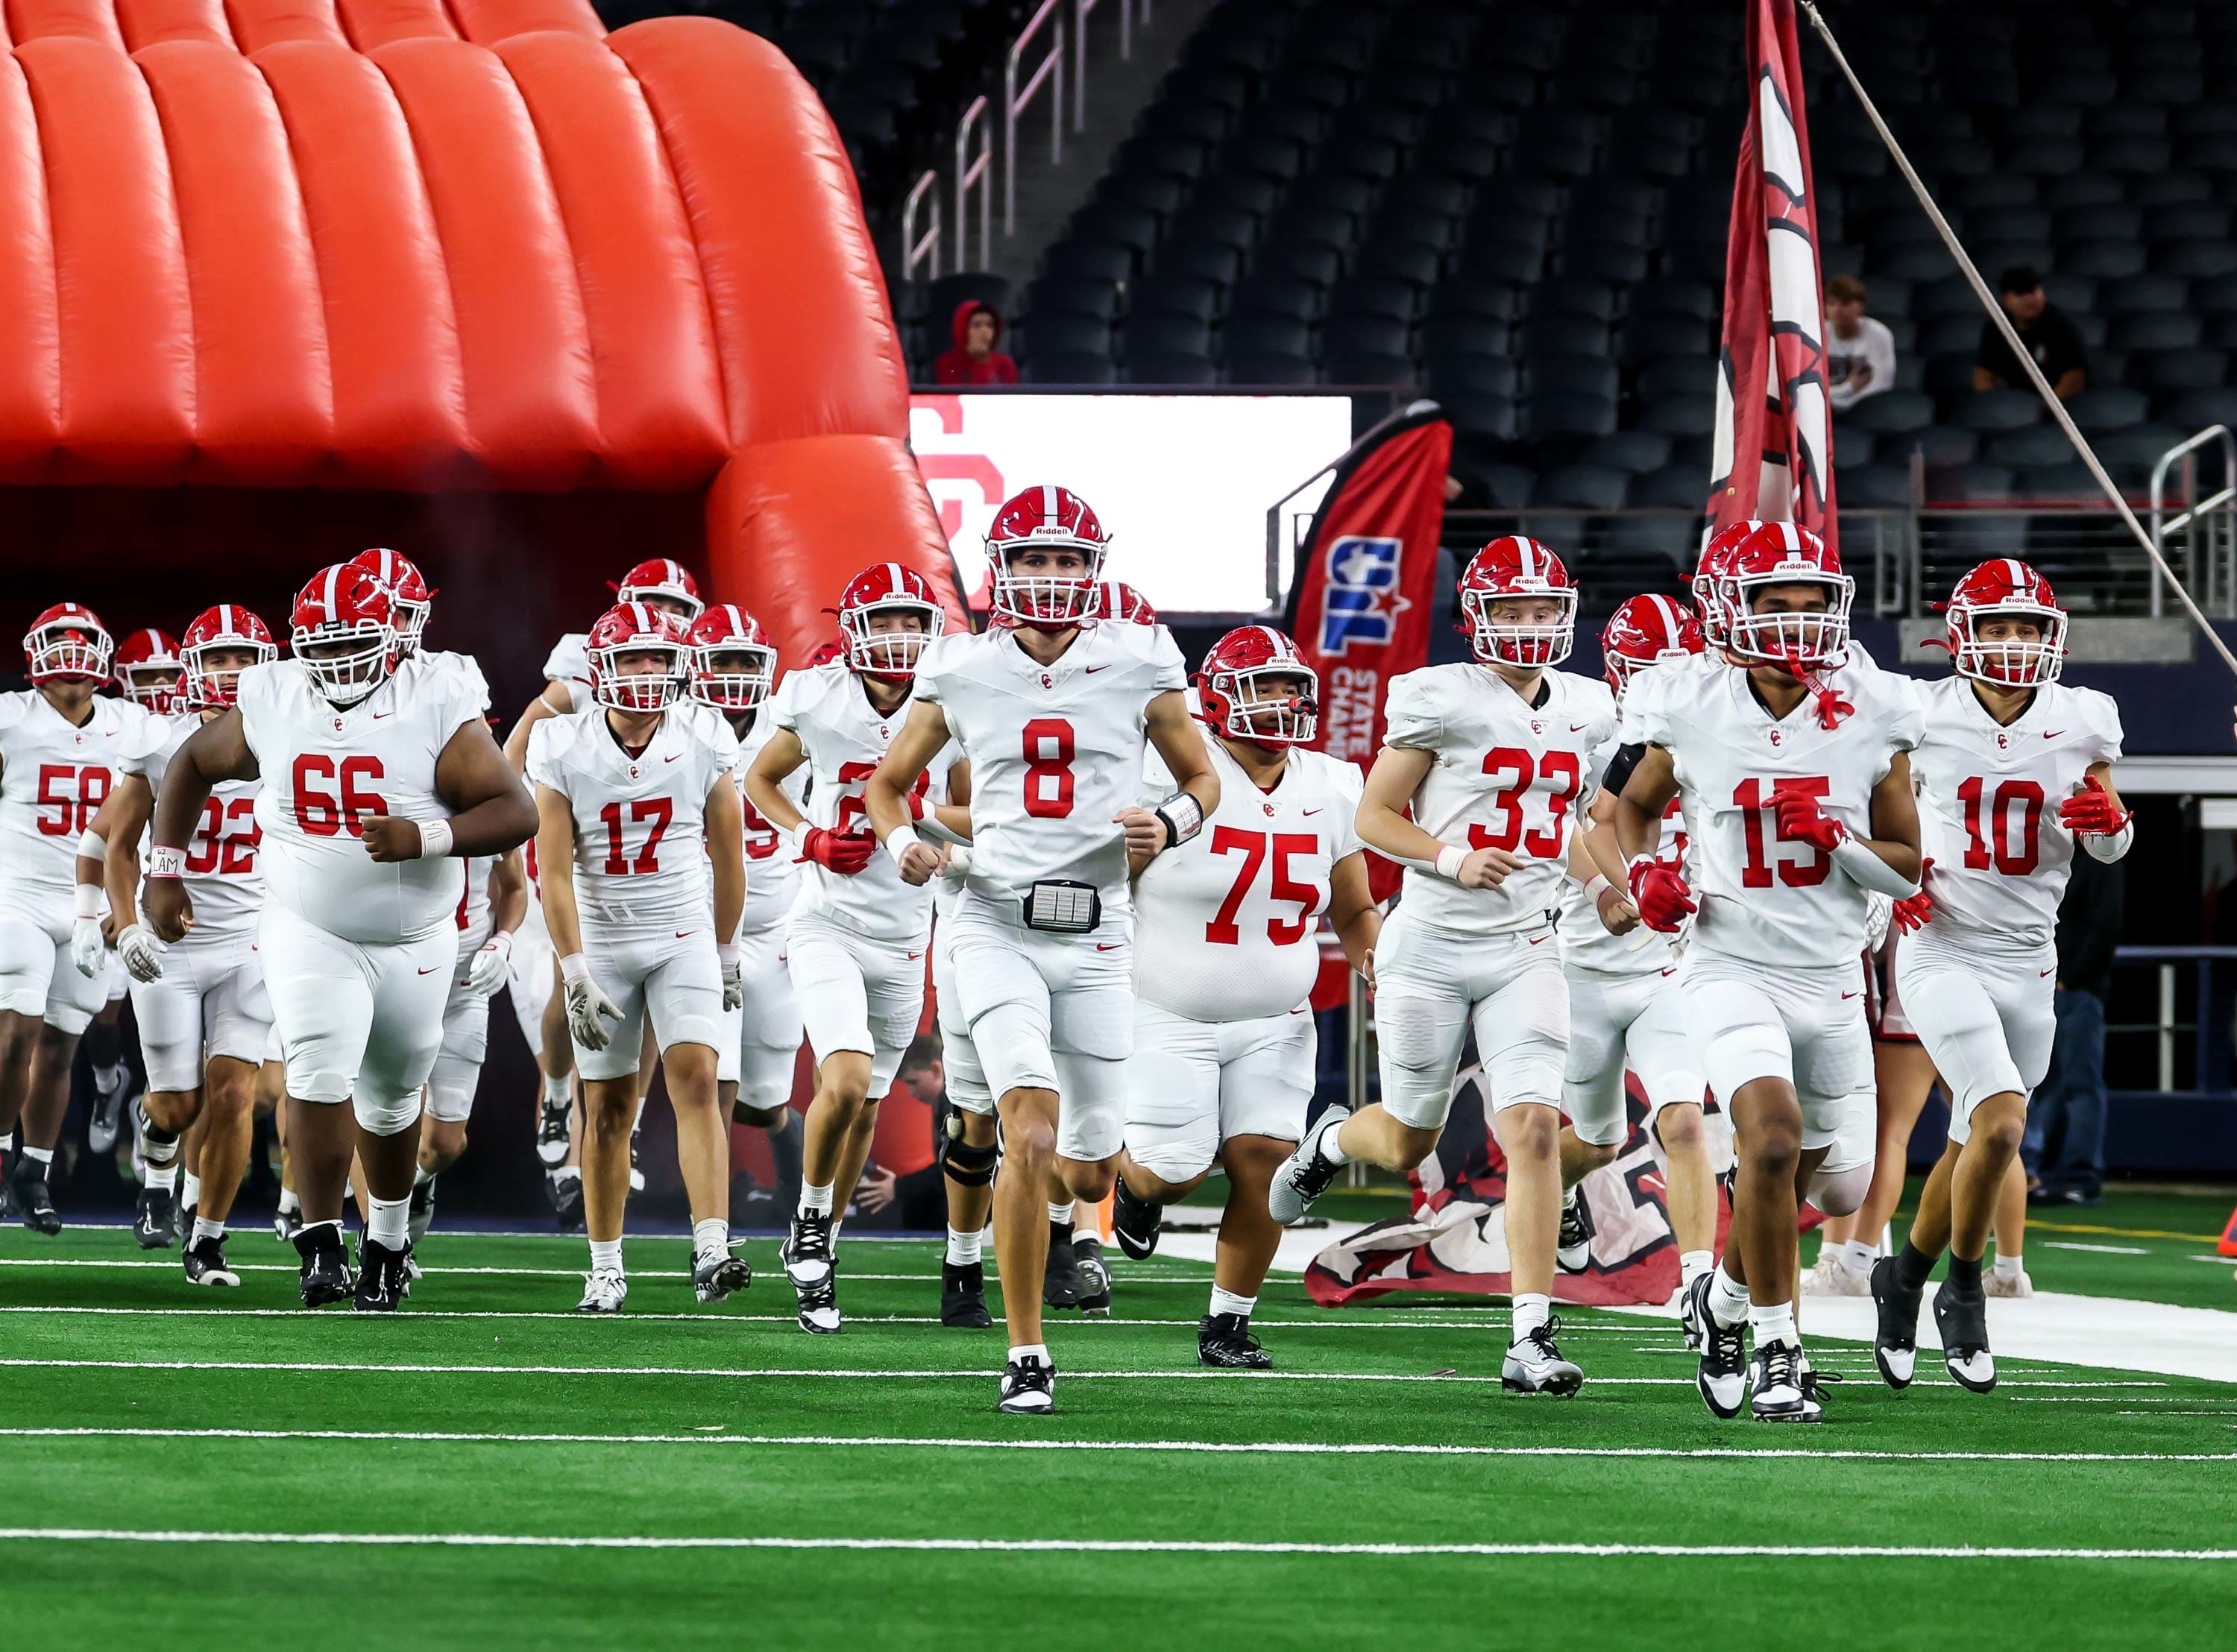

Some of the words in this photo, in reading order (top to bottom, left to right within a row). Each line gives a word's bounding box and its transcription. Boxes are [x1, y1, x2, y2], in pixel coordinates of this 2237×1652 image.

[1318, 535, 1412, 658] UIL
[1349, 669, 1377, 757] STATE
[37, 764, 111, 836] 58
[292, 753, 388, 838] 66
[1022, 718, 1075, 819] 8
[1467, 746, 1579, 859] 33
[185, 795, 262, 874] 32
[600, 796, 673, 875] 17
[1733, 775, 1831, 888] 15
[1957, 776, 2045, 876] 10
[1206, 825, 1320, 946] 75
